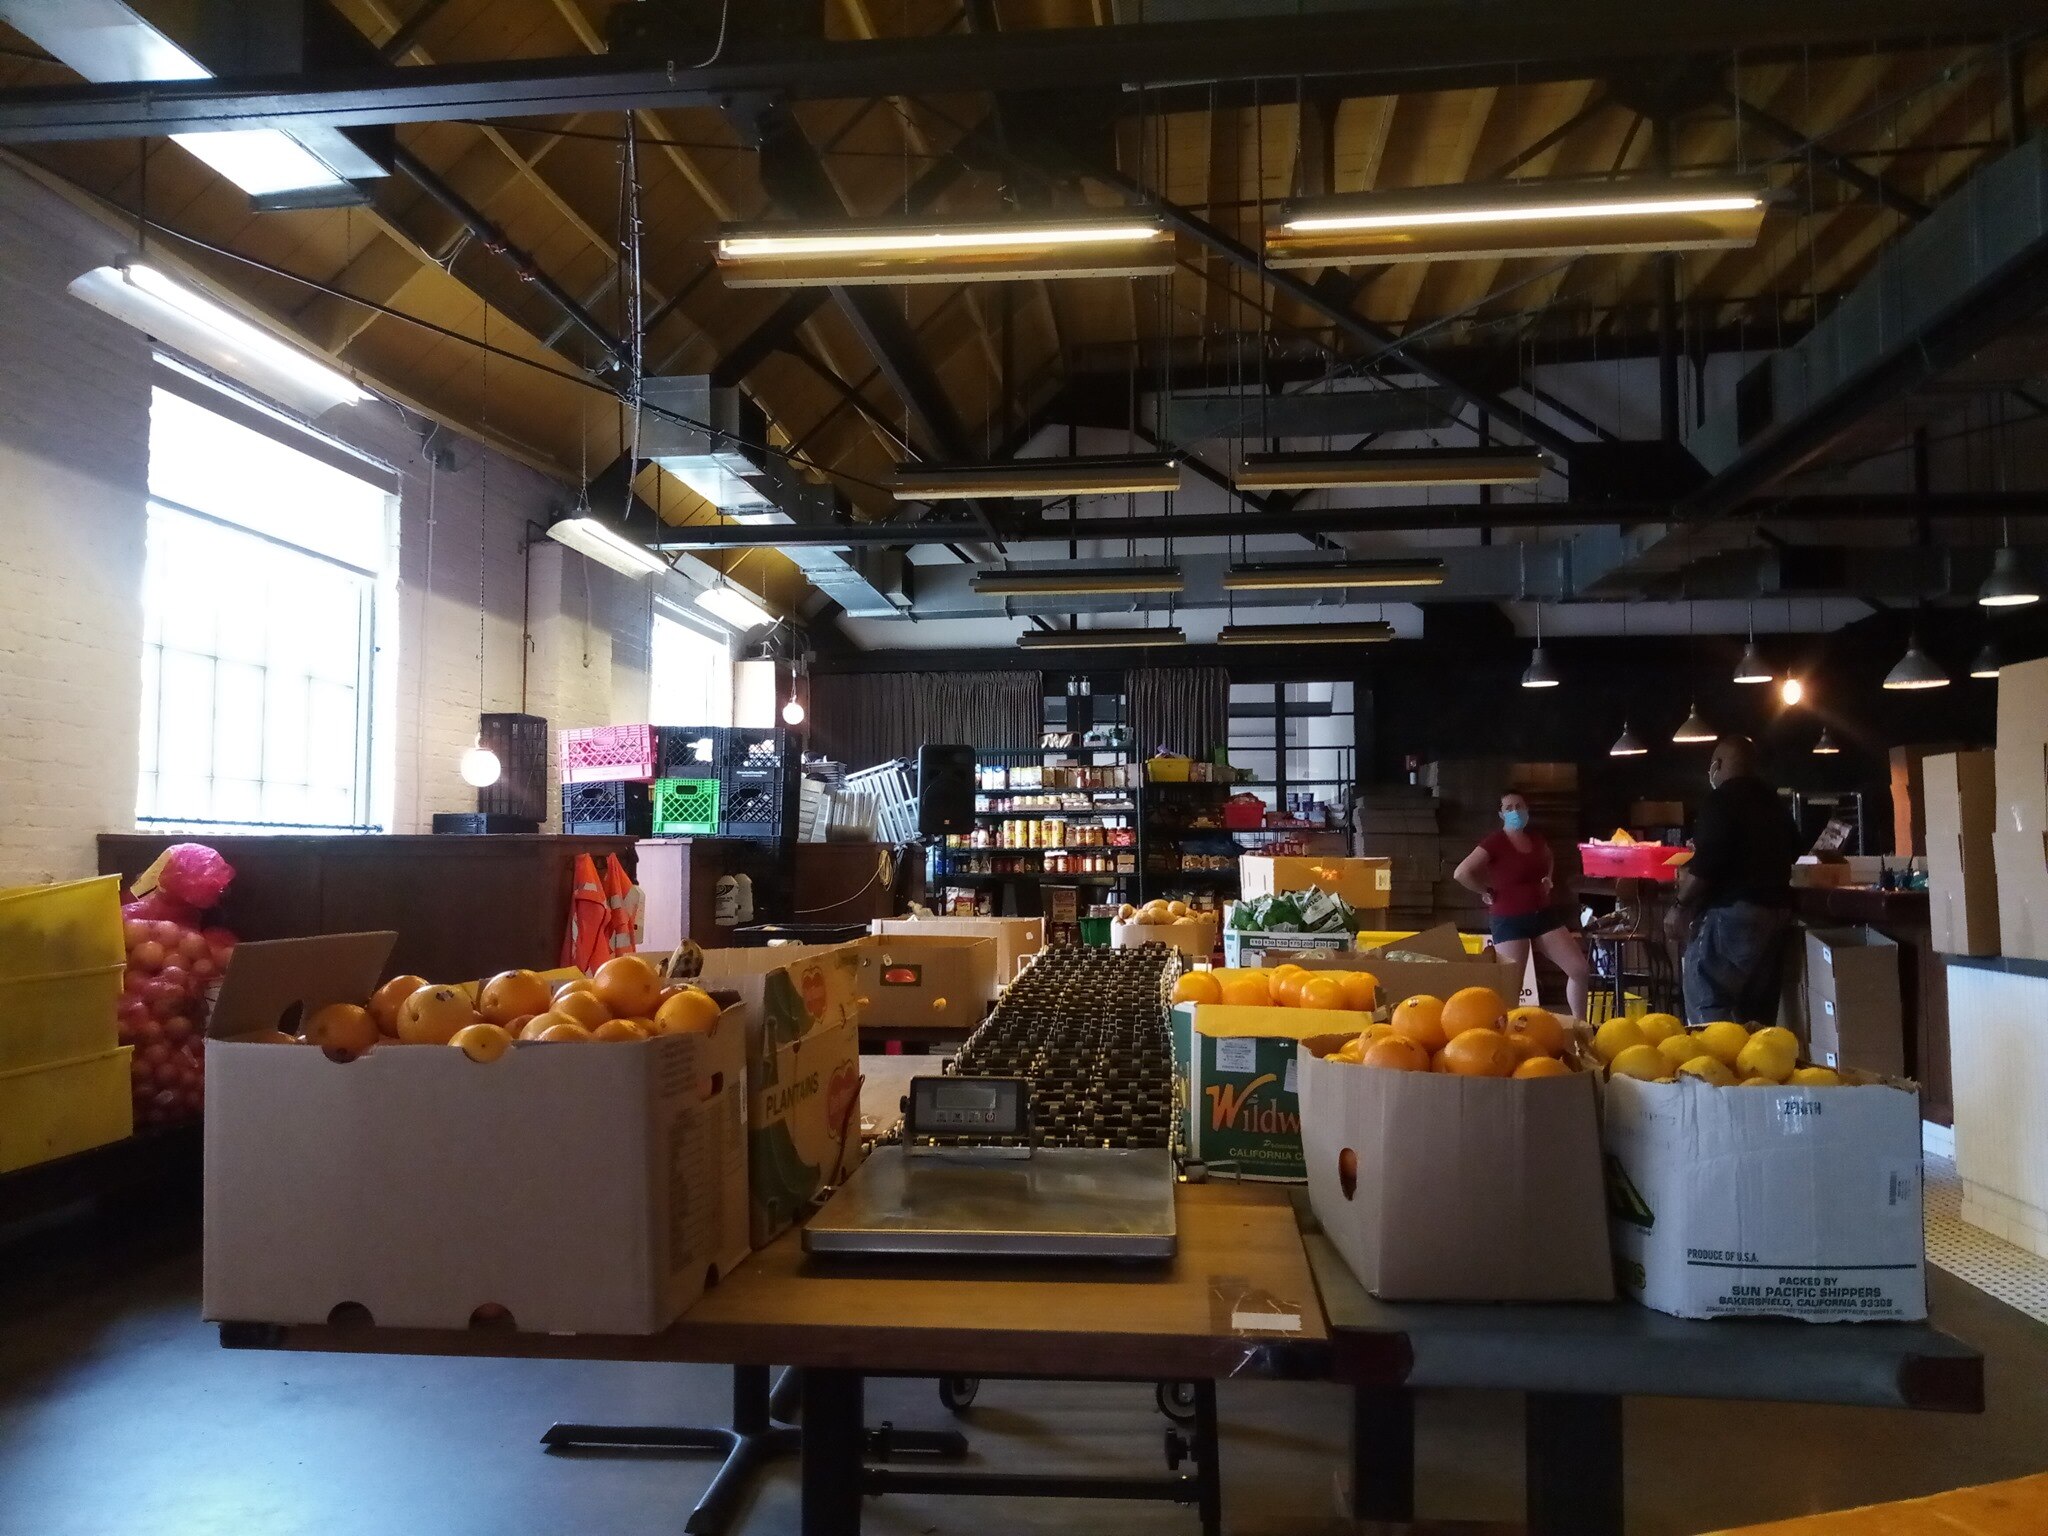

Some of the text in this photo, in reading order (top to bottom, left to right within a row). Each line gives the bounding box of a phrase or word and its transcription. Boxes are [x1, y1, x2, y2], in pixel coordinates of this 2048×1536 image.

[1229, 1147, 1292, 1159] CALIFORNIA
[1687, 1248, 1759, 1262] PRODUCE OF U.S.A.
[1779, 1277, 1838, 1286] PACKED BY
[1732, 1286, 1881, 1297] SUN PACIFIC SHIPPERS
[1719, 1296, 1793, 1307] BAKERSFIELD,
[1796, 1299, 1857, 1307] CALIFORNIA
